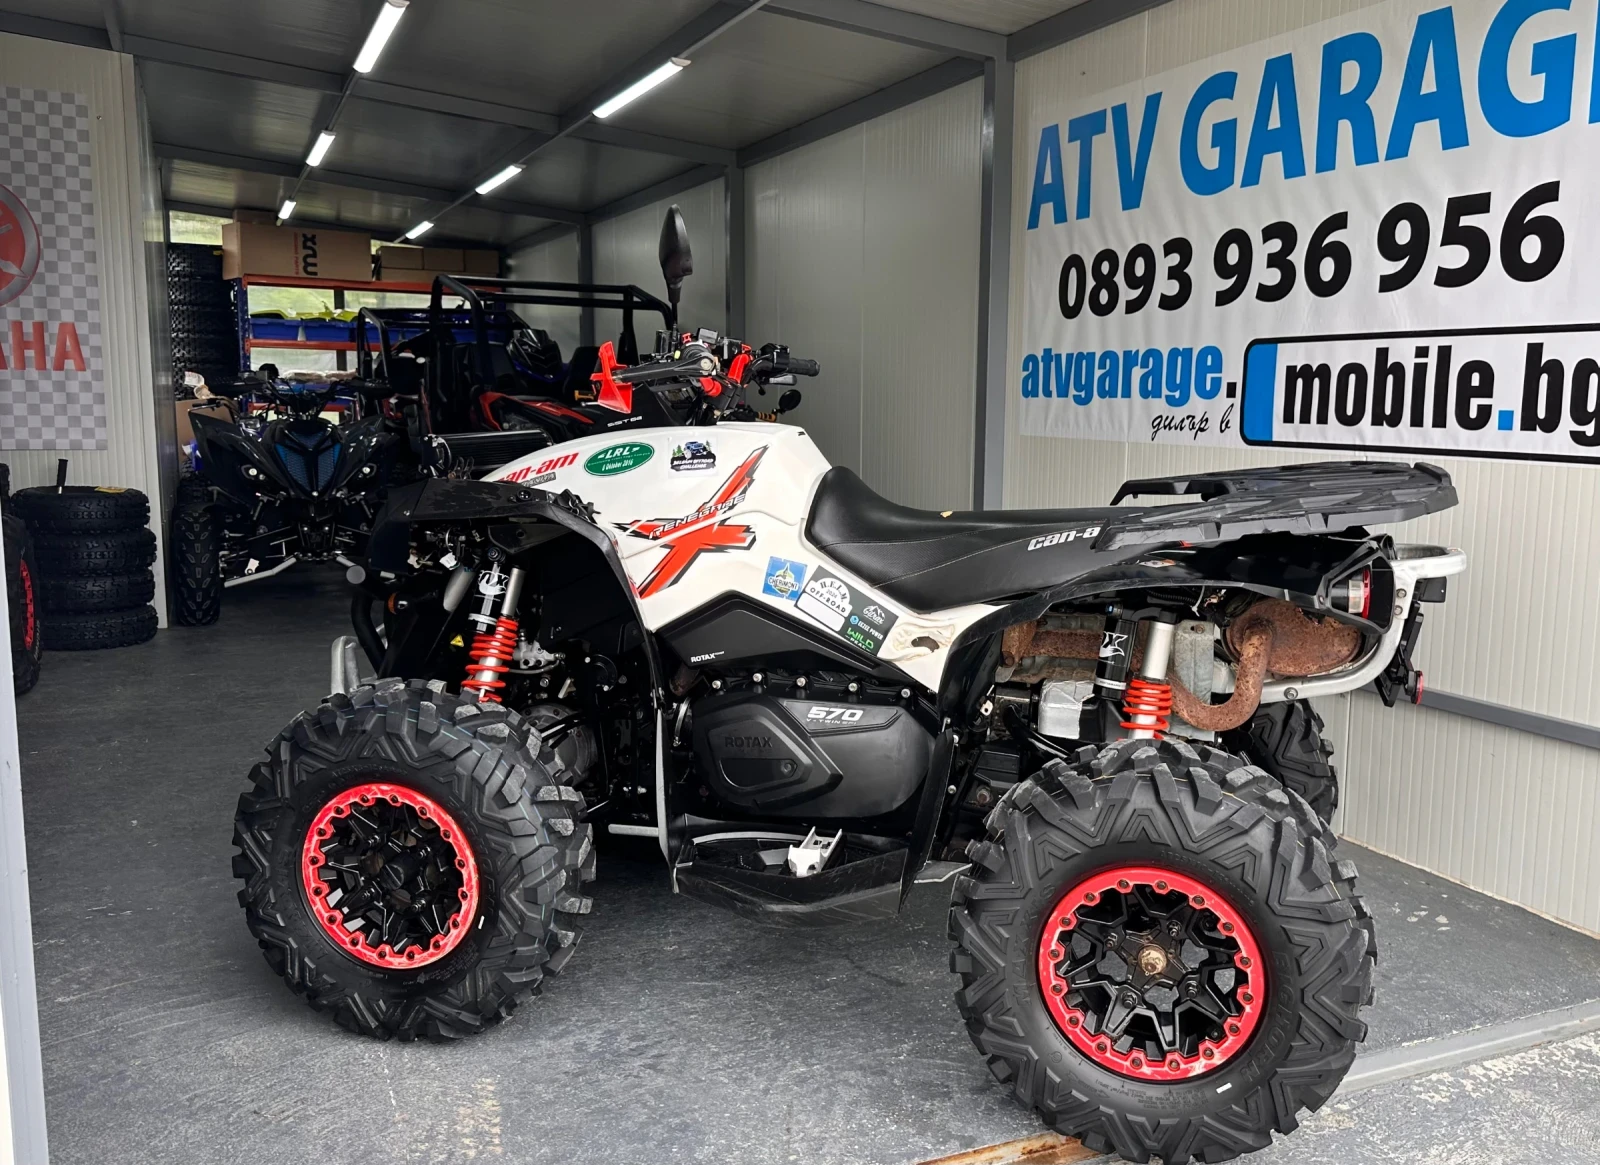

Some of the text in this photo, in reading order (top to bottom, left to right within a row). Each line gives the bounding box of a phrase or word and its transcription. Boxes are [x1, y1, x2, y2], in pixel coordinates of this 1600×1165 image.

[1027, 0, 1600, 230] ATV GARAG
[1058, 180, 1566, 320] 0893 936 956
[1151, 411, 1210, 442] дилър
[604, 445, 631, 460] LRL
[498, 452, 580, 483] an-am
[648, 493, 746, 541] RENEGADE
[825, 588, 839, 599] 2024
[846, 627, 874, 649] WILD
[690, 652, 716, 663] ROTAX
[806, 706, 864, 722] 570
[724, 736, 773, 748] ROTAX
